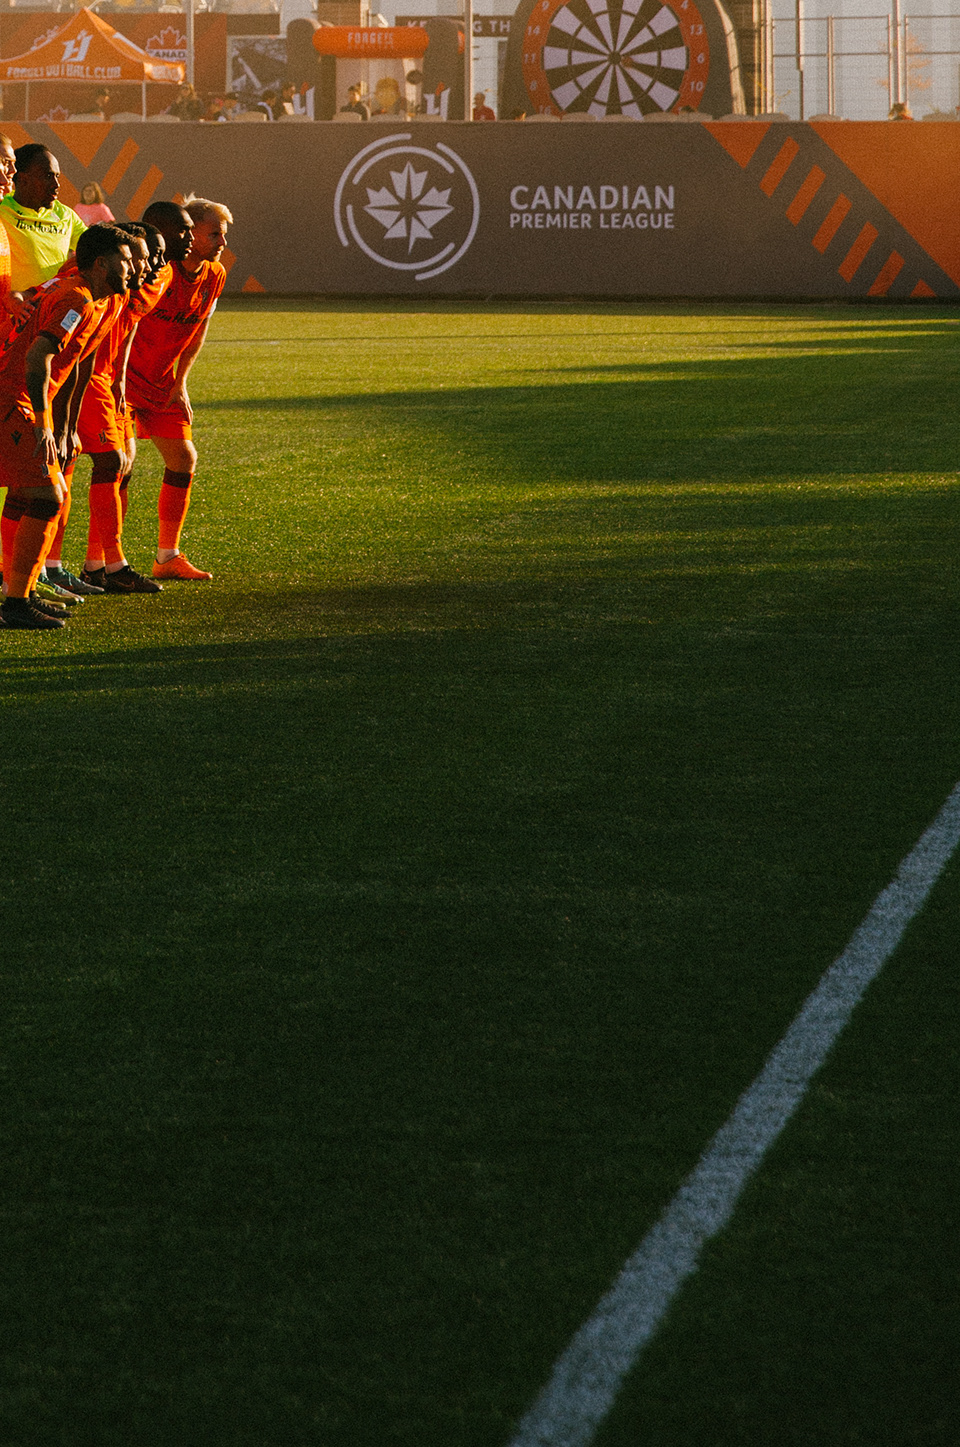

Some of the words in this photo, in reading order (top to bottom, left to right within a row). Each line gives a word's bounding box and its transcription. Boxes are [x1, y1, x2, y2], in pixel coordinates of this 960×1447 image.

[542, 0, 550, 11] 9
[681, 0, 689, 10] 4
[527, 25, 540, 35] 14
[690, 24, 703, 35] 13
[348, 32, 382, 44] FORGE
[525, 53, 537, 64] 11
[697, 54, 705, 64] 6
[530, 80, 537, 91] 8
[690, 81, 704, 91] 10
[509, 185, 675, 210] CANADIAN
[509, 213, 592, 229] PREMIER
[599, 213, 675, 229] LEAGUE
